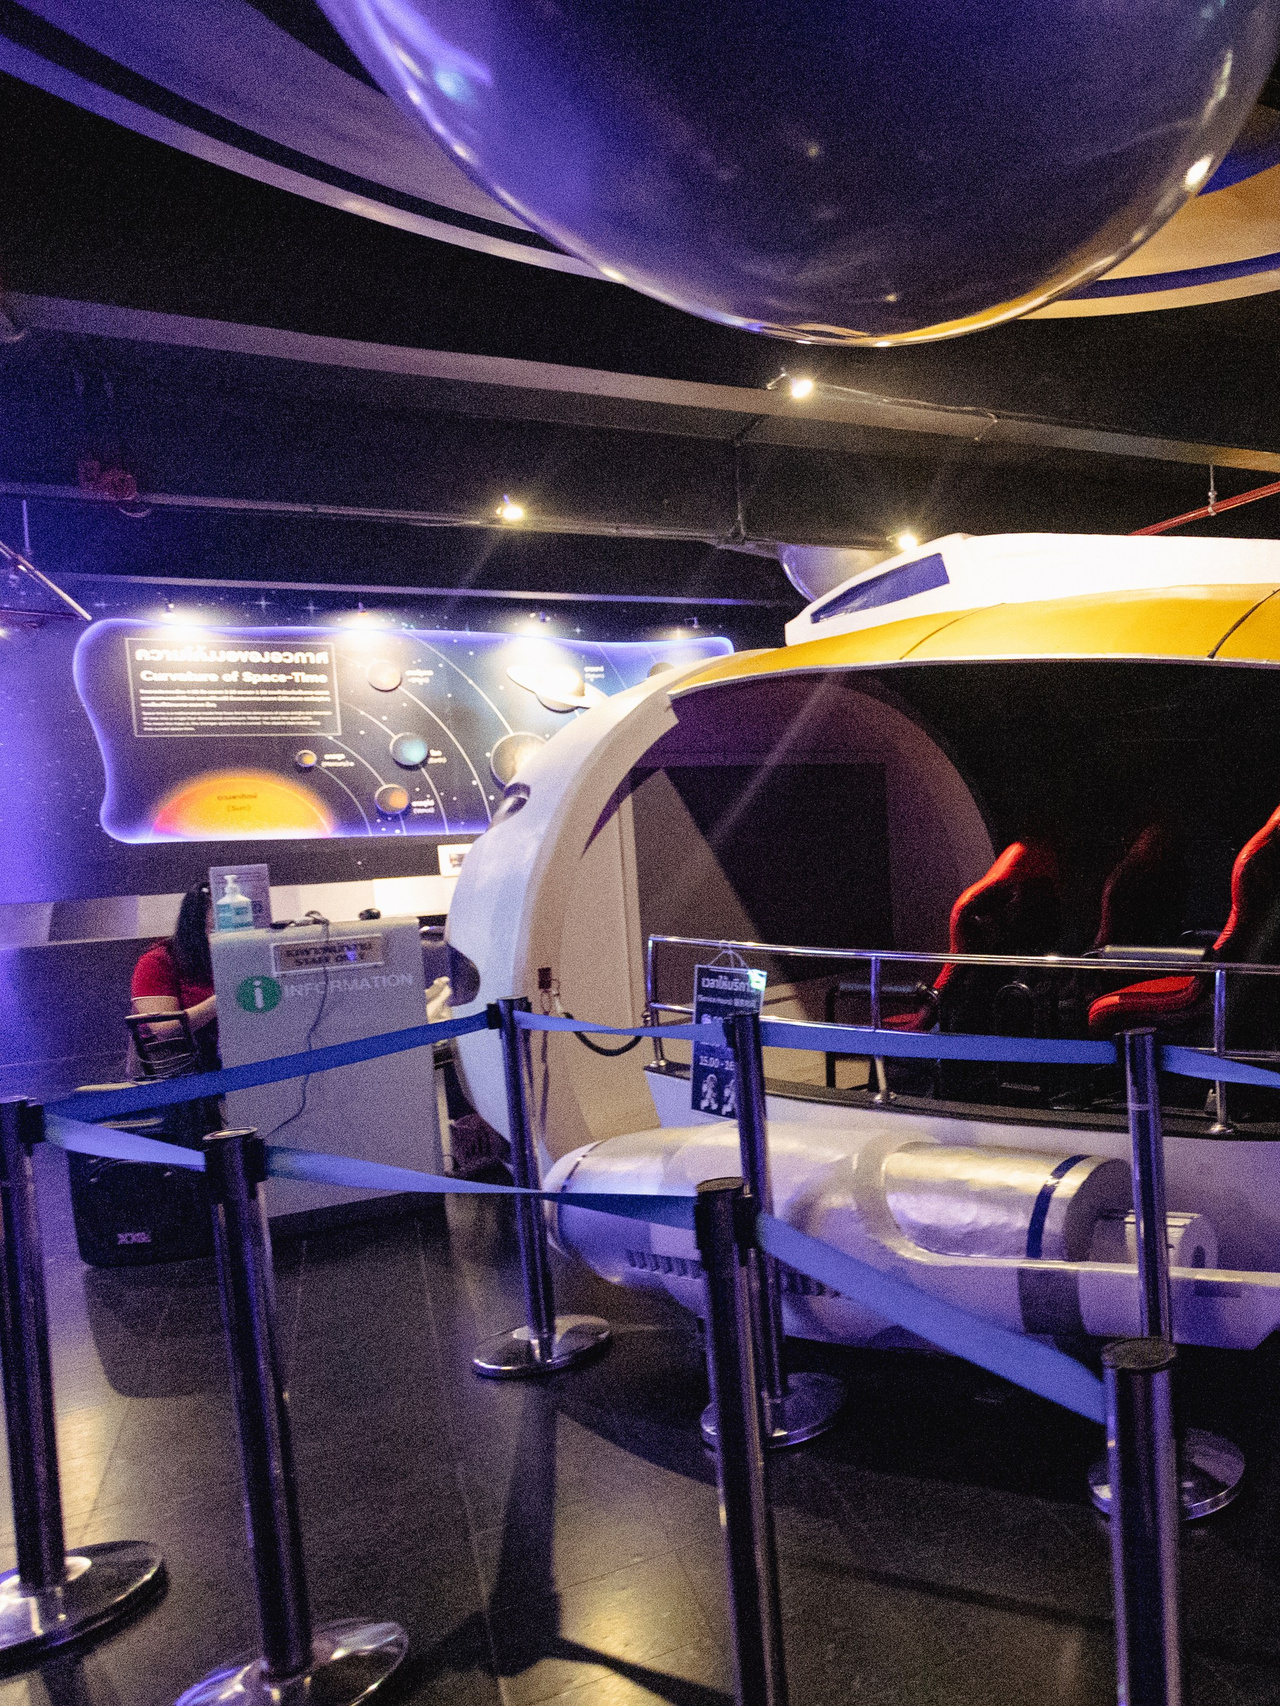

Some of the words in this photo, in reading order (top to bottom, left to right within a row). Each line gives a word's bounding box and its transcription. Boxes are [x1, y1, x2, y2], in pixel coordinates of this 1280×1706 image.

[140, 670, 219, 682] Curvature
[222, 671, 239, 682] of
[242, 671, 328, 684] Space-Time
[283, 973, 414, 997] INFORMATION
